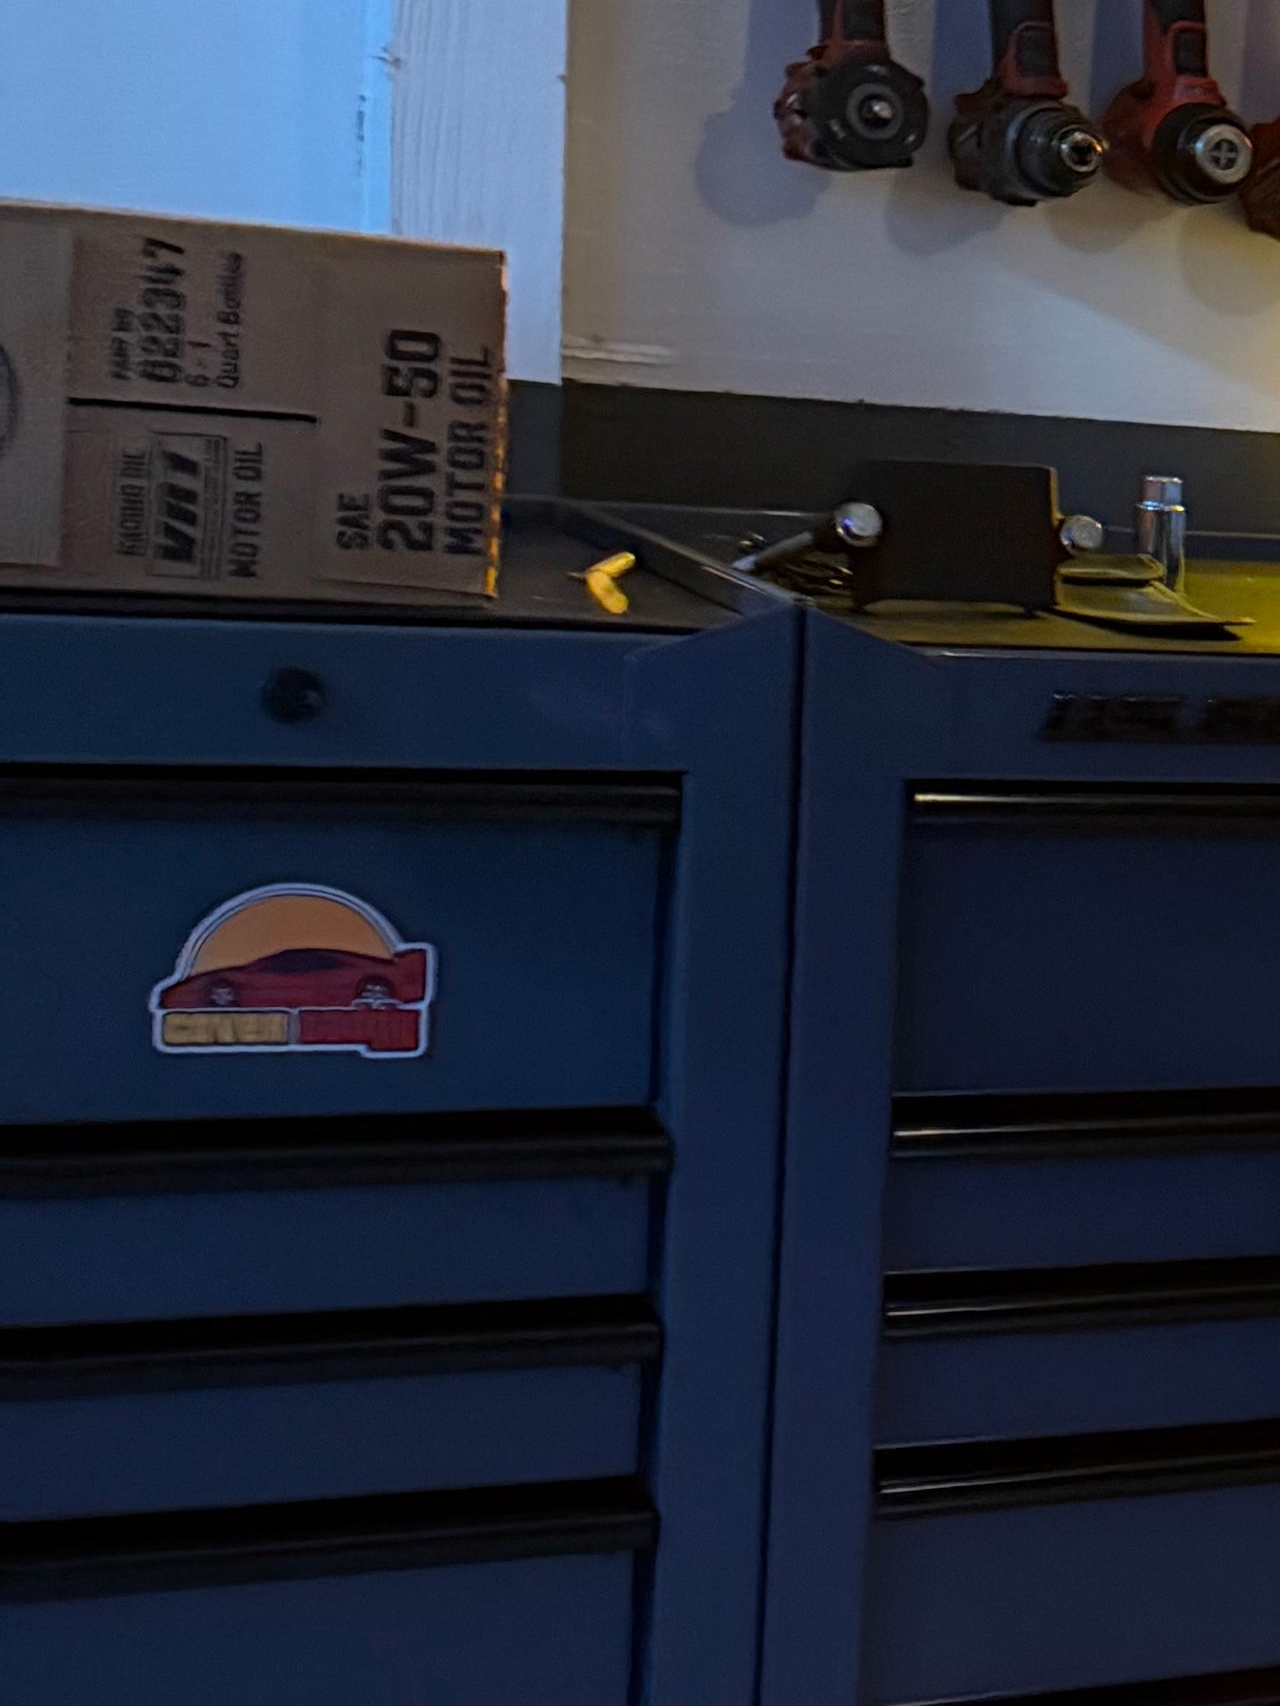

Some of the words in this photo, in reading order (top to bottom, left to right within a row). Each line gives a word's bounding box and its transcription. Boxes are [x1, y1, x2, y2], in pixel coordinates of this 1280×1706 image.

[214, 331, 243, 389] Quart
[448, 345, 491, 406] OIL
[235, 442, 264, 481] OIL
[377, 329, 441, 553] 20W-50
[443, 419, 488, 557] MOTOR
[228, 490, 262, 579] MOTOR
[336, 492, 371, 551] SAE
